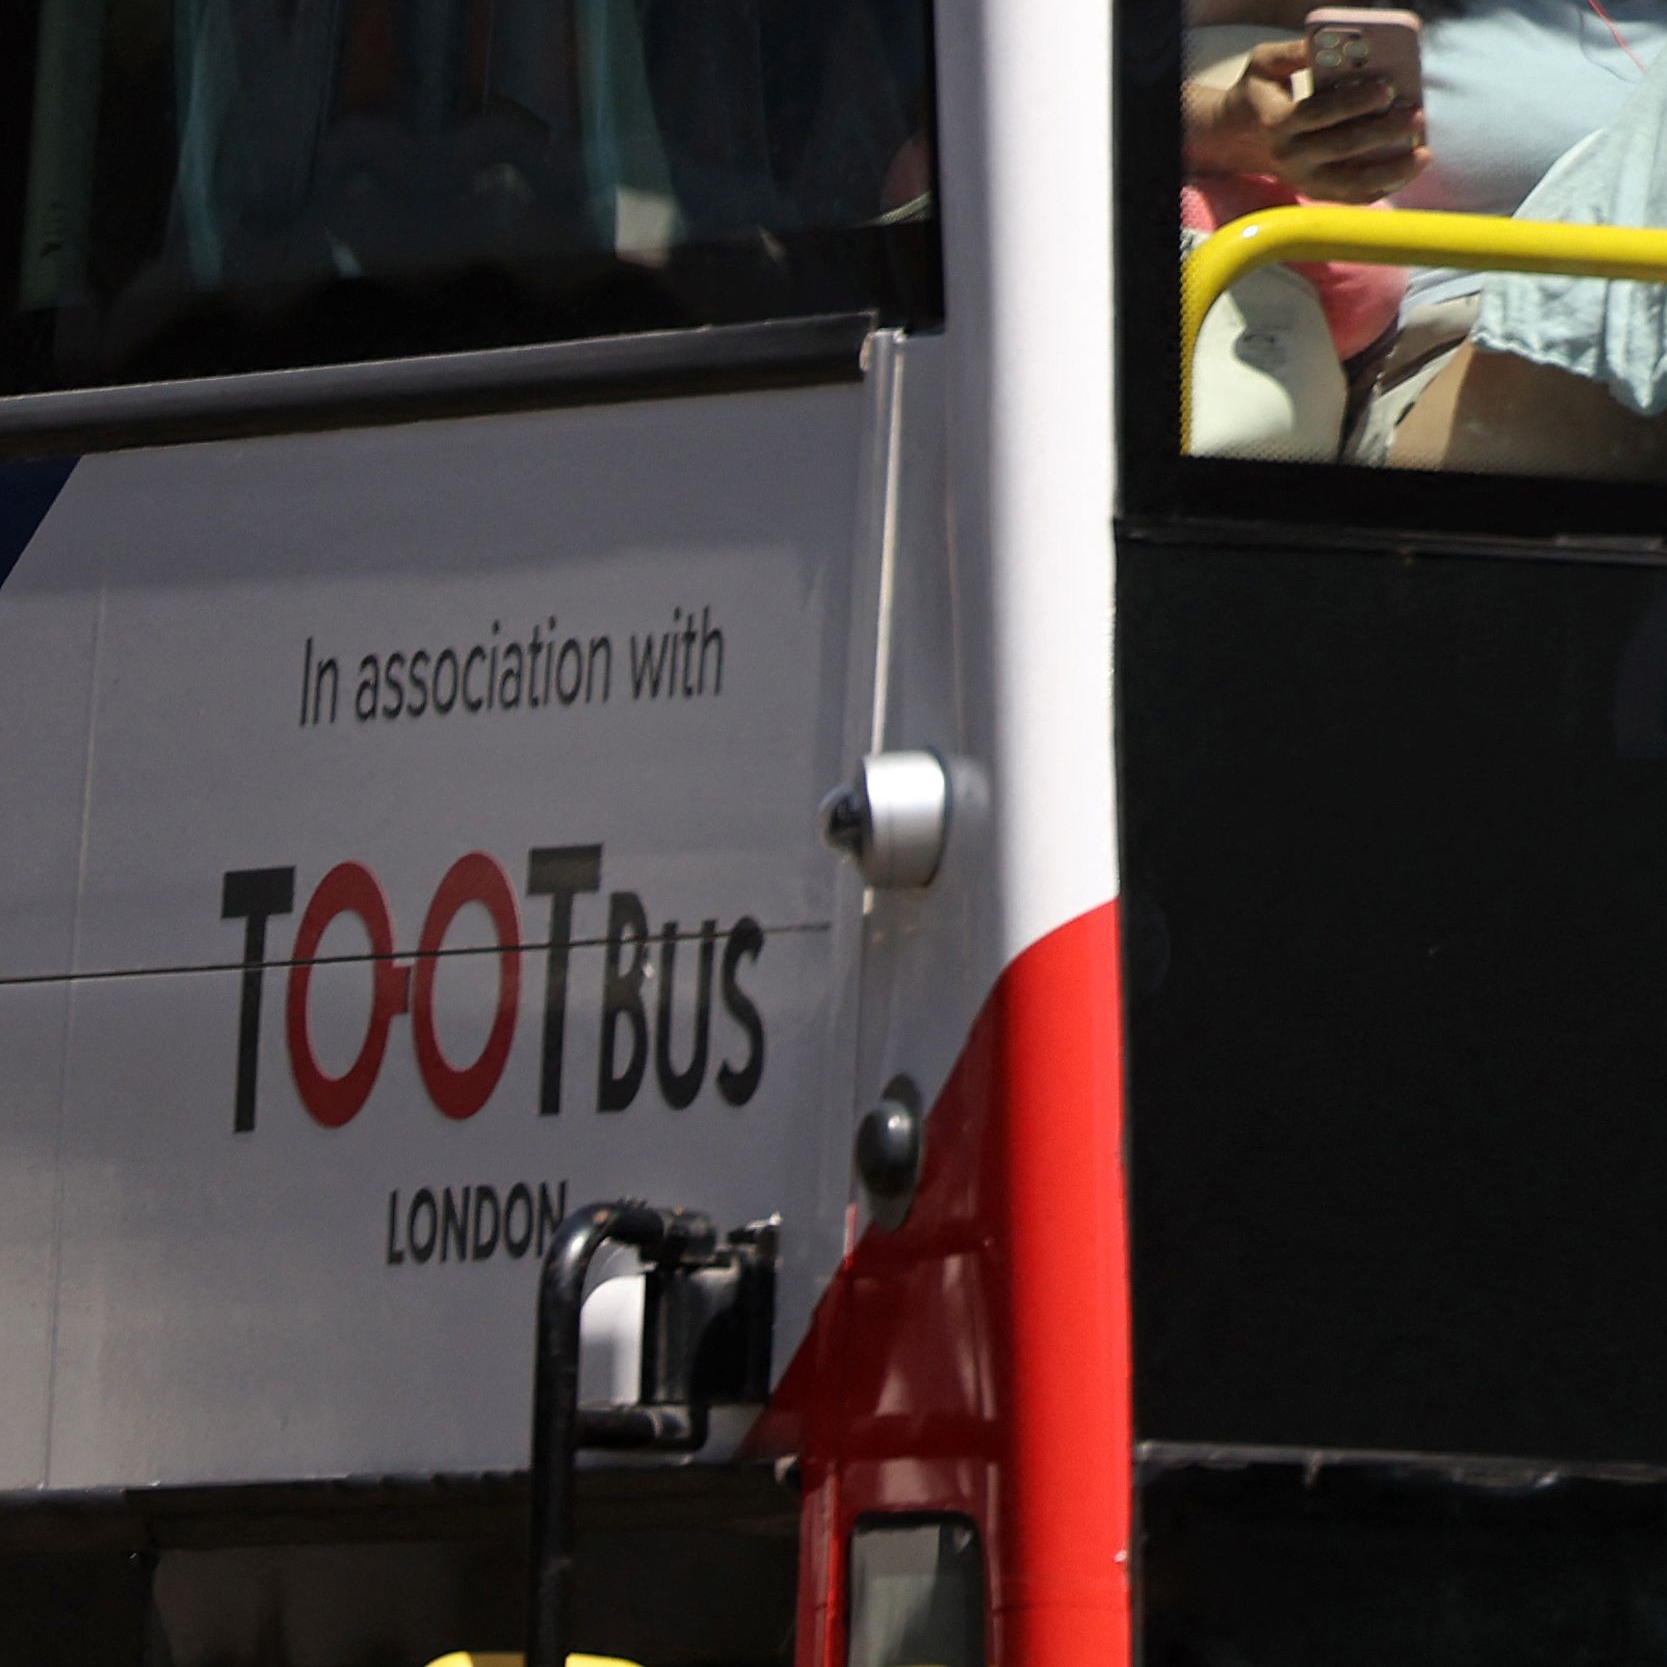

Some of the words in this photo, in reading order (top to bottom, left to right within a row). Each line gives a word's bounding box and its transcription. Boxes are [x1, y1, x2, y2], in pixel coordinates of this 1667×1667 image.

[299, 636, 340, 727] In
[354, 614, 613, 722] association
[630, 605, 724, 699] with
[387, 1179, 569, 1266] LONDON
